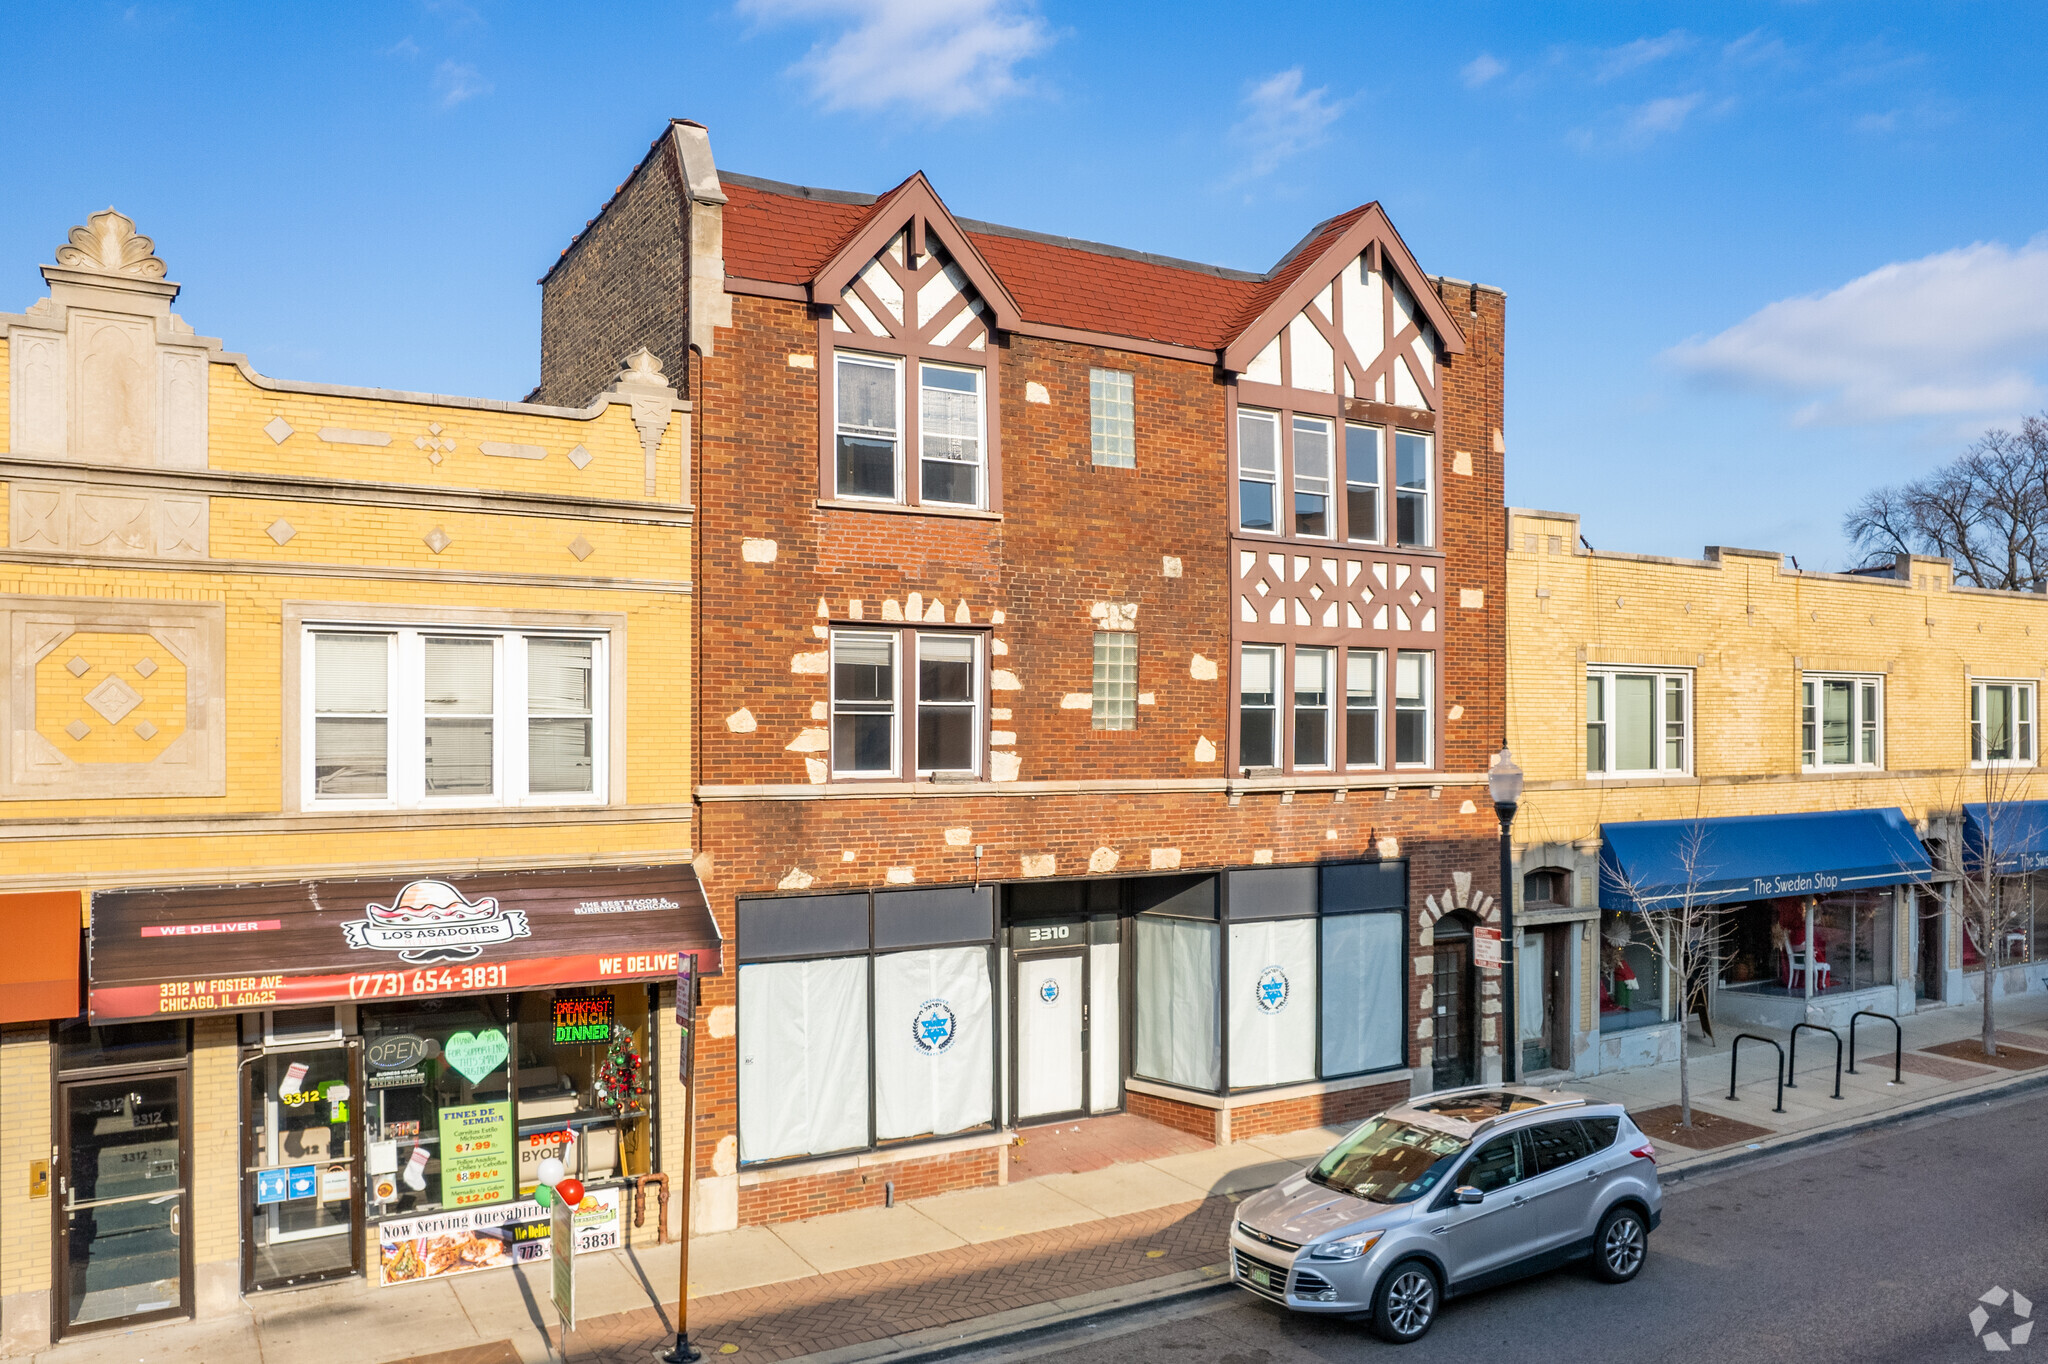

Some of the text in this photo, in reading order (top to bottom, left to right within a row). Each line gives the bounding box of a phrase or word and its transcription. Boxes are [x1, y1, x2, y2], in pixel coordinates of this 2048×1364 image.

[1753, 872, 1838, 895] The Sweden Shop
[627, 898, 658, 906] TACOS
[574, 905, 623, 915] BURRITOS
[160, 922, 258, 935] WE DELIVER
[382, 925, 499, 940] LOS ASADORES
[1029, 926, 1069, 942] 3310
[599, 954, 677, 975] WE DELIVE
[160, 975, 287, 997] 3312 W FOSTER AVE.
[349, 965, 507, 999] (773) 654-3831
[160, 991, 276, 1013] CHICAGO, IL 60625
[556, 1000, 609, 1014] BREAKFAST
[557, 1011, 608, 1027] LUNCH
[556, 1024, 609, 1042] DINNER
[369, 1041, 423, 1062] OPEN
[95, 1098, 125, 1111] 3312
[284, 1090, 319, 1105] 3312
[133, 1112, 162, 1125] 3312
[444, 1107, 495, 1120] FINES DE
[463, 1115, 504, 1126] SEMANA
[530, 1130, 573, 1147] BYOB
[456, 1141, 490, 1152] $7.99
[482, 1169, 498, 1179] c/u
[457, 1191, 499, 1204] $12.00
[383, 1225, 411, 1239] Now
[417, 1214, 469, 1234] Serving
[515, 1227, 528, 1240] We
